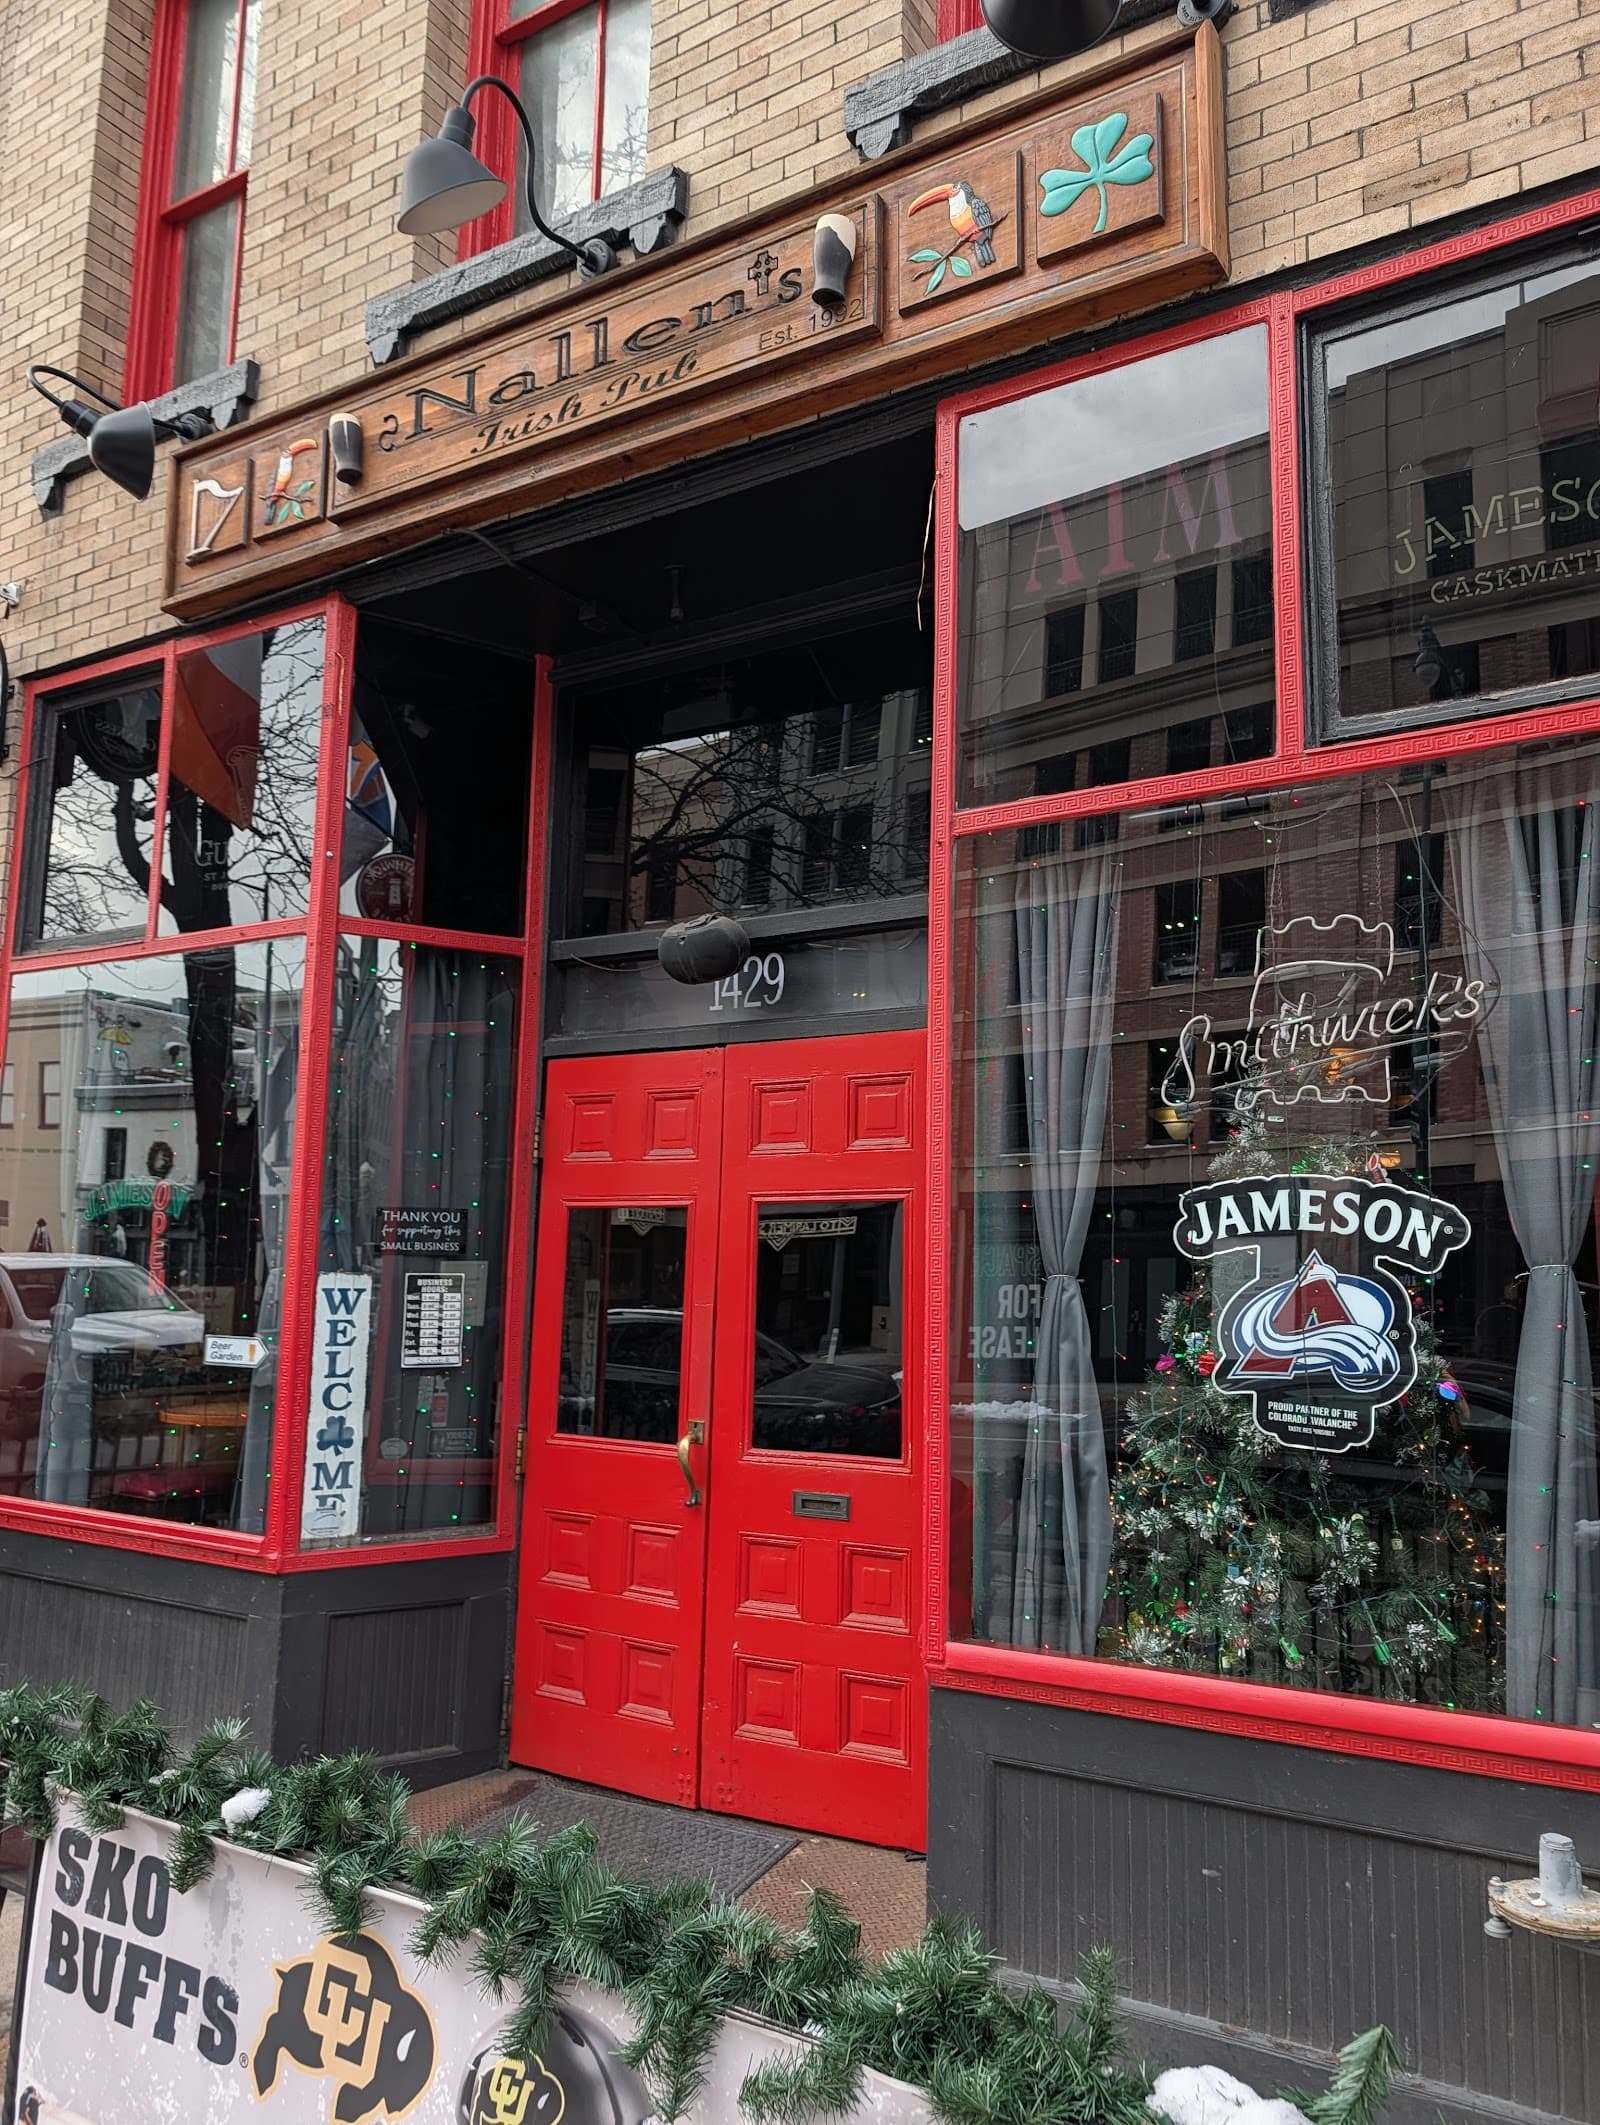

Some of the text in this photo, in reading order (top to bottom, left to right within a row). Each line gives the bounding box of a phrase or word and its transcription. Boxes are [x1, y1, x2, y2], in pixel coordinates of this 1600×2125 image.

[759, 298, 862, 351] Est. 1992
[471, 347, 699, 455] Irish Pub
[709, 952, 785, 1011] 1429
[83, 1177, 189, 1221] JAMESN
[382, 1210, 461, 1223] THANK YOU
[1186, 1189, 1446, 1258] JAMESON
[147, 1180, 172, 1297] OPEN
[381, 1223, 461, 1239] for supporting this
[381, 1241, 460, 1251] SMALL BUSINESS
[210, 1341, 233, 1350] Beer
[210, 1351, 244, 1361] Garden
[311, 1287, 367, 1517] WELCME
[1267, 1401, 1294, 1412] PROUD
[1331, 1408, 1342, 1418] OF
[1343, 1409, 1358, 1420] THE
[55, 1827, 170, 1938] SKO
[44, 1909, 240, 2066] BUFFS
